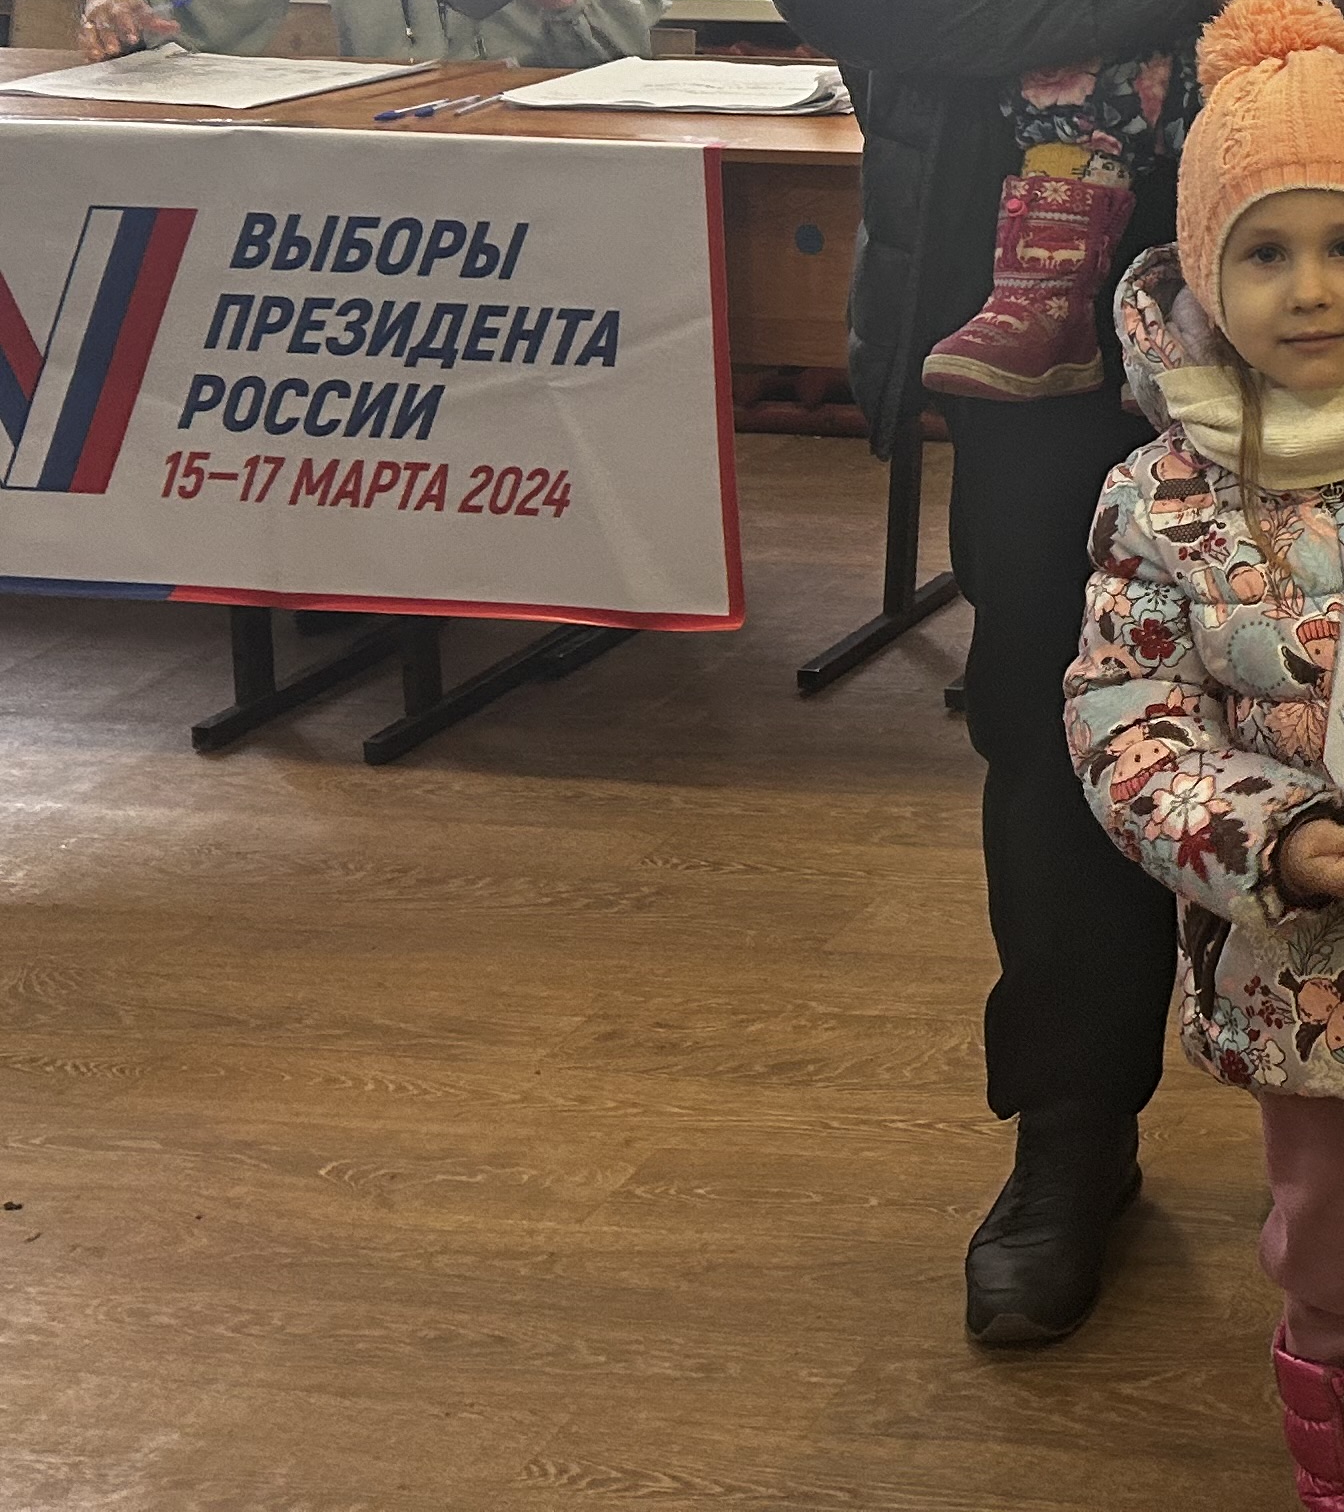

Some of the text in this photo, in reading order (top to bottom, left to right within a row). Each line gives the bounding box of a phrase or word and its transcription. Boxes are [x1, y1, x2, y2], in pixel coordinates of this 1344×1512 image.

[229, 211, 530, 280] ВЫБОРЫ
[203, 293, 621, 369] ПРЕЗИДЕНТА
[177, 374, 446, 441] РОССИИ
[287, 459, 449, 513] МАРТА
[458, 465, 573, 519] 2024
